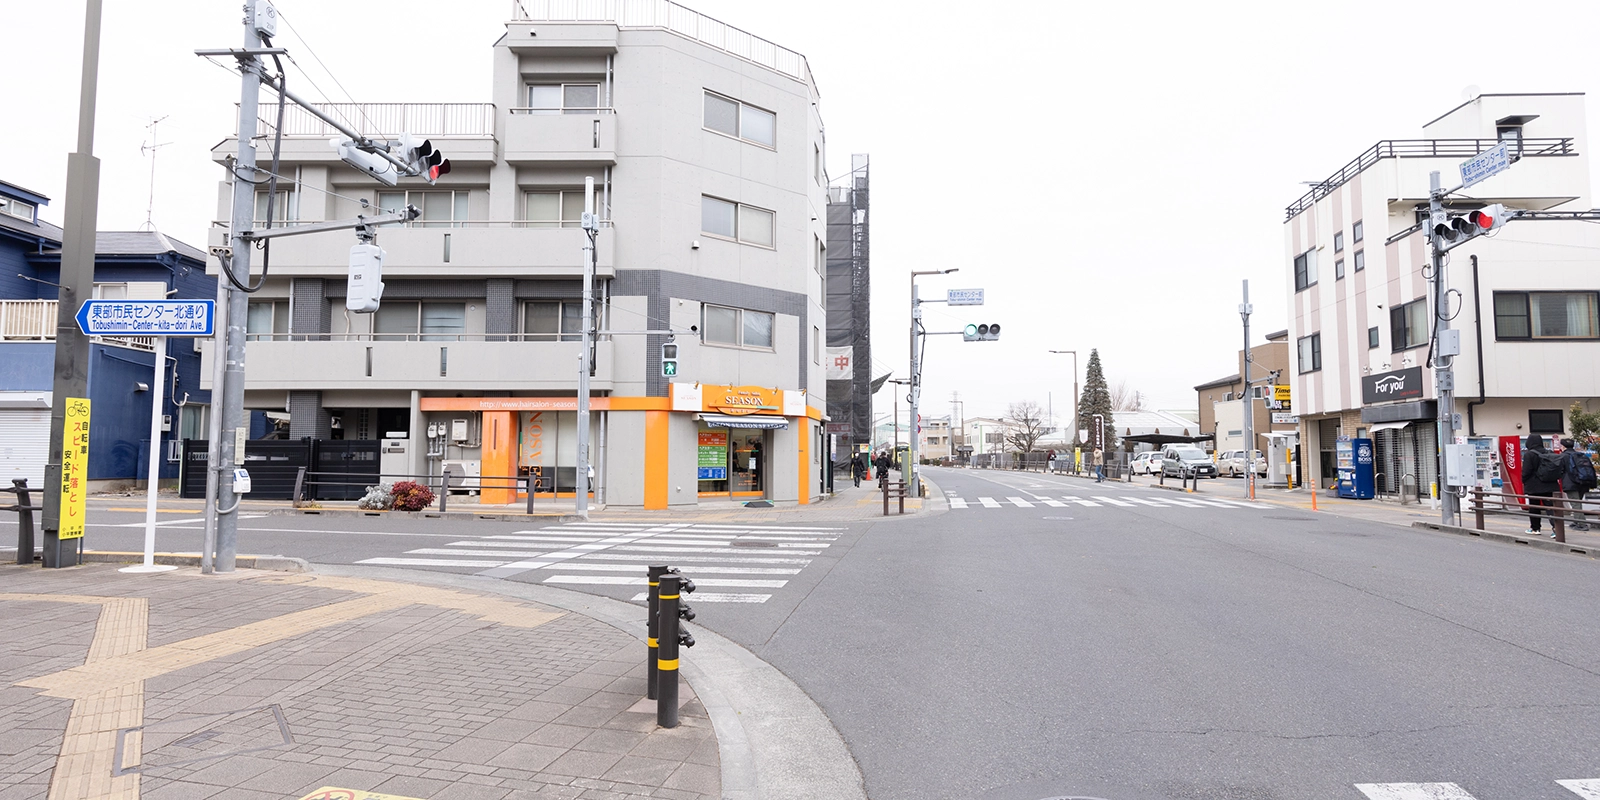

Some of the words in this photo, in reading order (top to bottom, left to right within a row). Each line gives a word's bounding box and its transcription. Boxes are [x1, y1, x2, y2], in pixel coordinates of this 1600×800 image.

[91, 305, 205, 319] 東部市民センター北通り
[92, 319, 187, 330] Tobushimin-Center-kita-dori
[190, 320, 204, 330] Ave.
[1375, 381, 1389, 394] For
[1390, 380, 1405, 394] you
[479, 401, 593, 410] http://www.hairsalon-season.
[725, 396, 764, 406] SEASON
[80, 421, 89, 455] 自転車
[62, 450, 72, 494] 安全運転
[69, 422, 82, 517] スピード落とし
